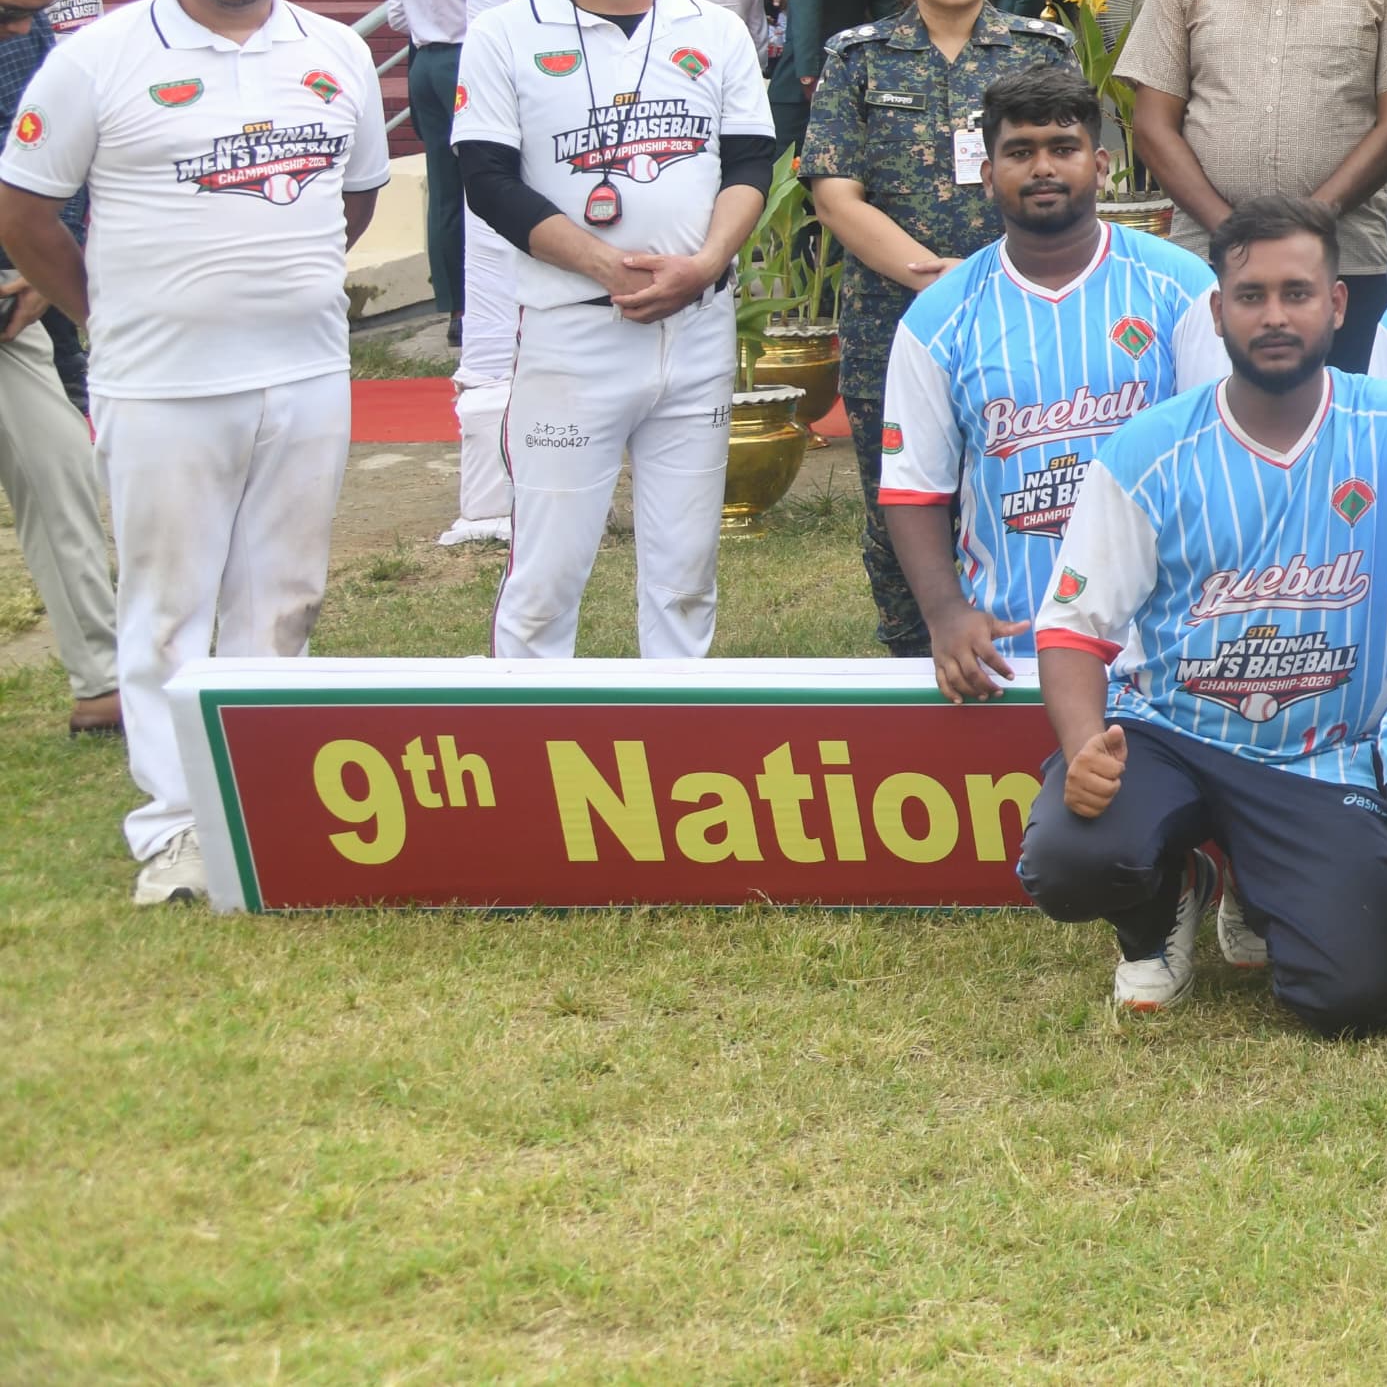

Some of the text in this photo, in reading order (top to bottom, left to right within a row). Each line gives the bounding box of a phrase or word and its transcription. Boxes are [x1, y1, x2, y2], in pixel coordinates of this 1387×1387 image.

[591, 101, 688, 125] NATIONAL
[215, 125, 327, 154] NATIONAL
[557, 117, 712, 160] MEN'S BASEBALL
[178, 146, 251, 183] MEN'S
[525, 435, 590, 448] @kicho0427
[533, 422, 579, 436] ふわっち
[1050, 455, 1078, 470] 9TH
[1025, 463, 1090, 490] NATIO
[1247, 626, 1278, 639] 9TH
[1244, 646, 1357, 679] BASEBALL
[1198, 675, 1333, 691] CHAMPIONSHIP-2026
[312, 735, 497, 866] 9th
[544, 740, 1042, 865] Nation
